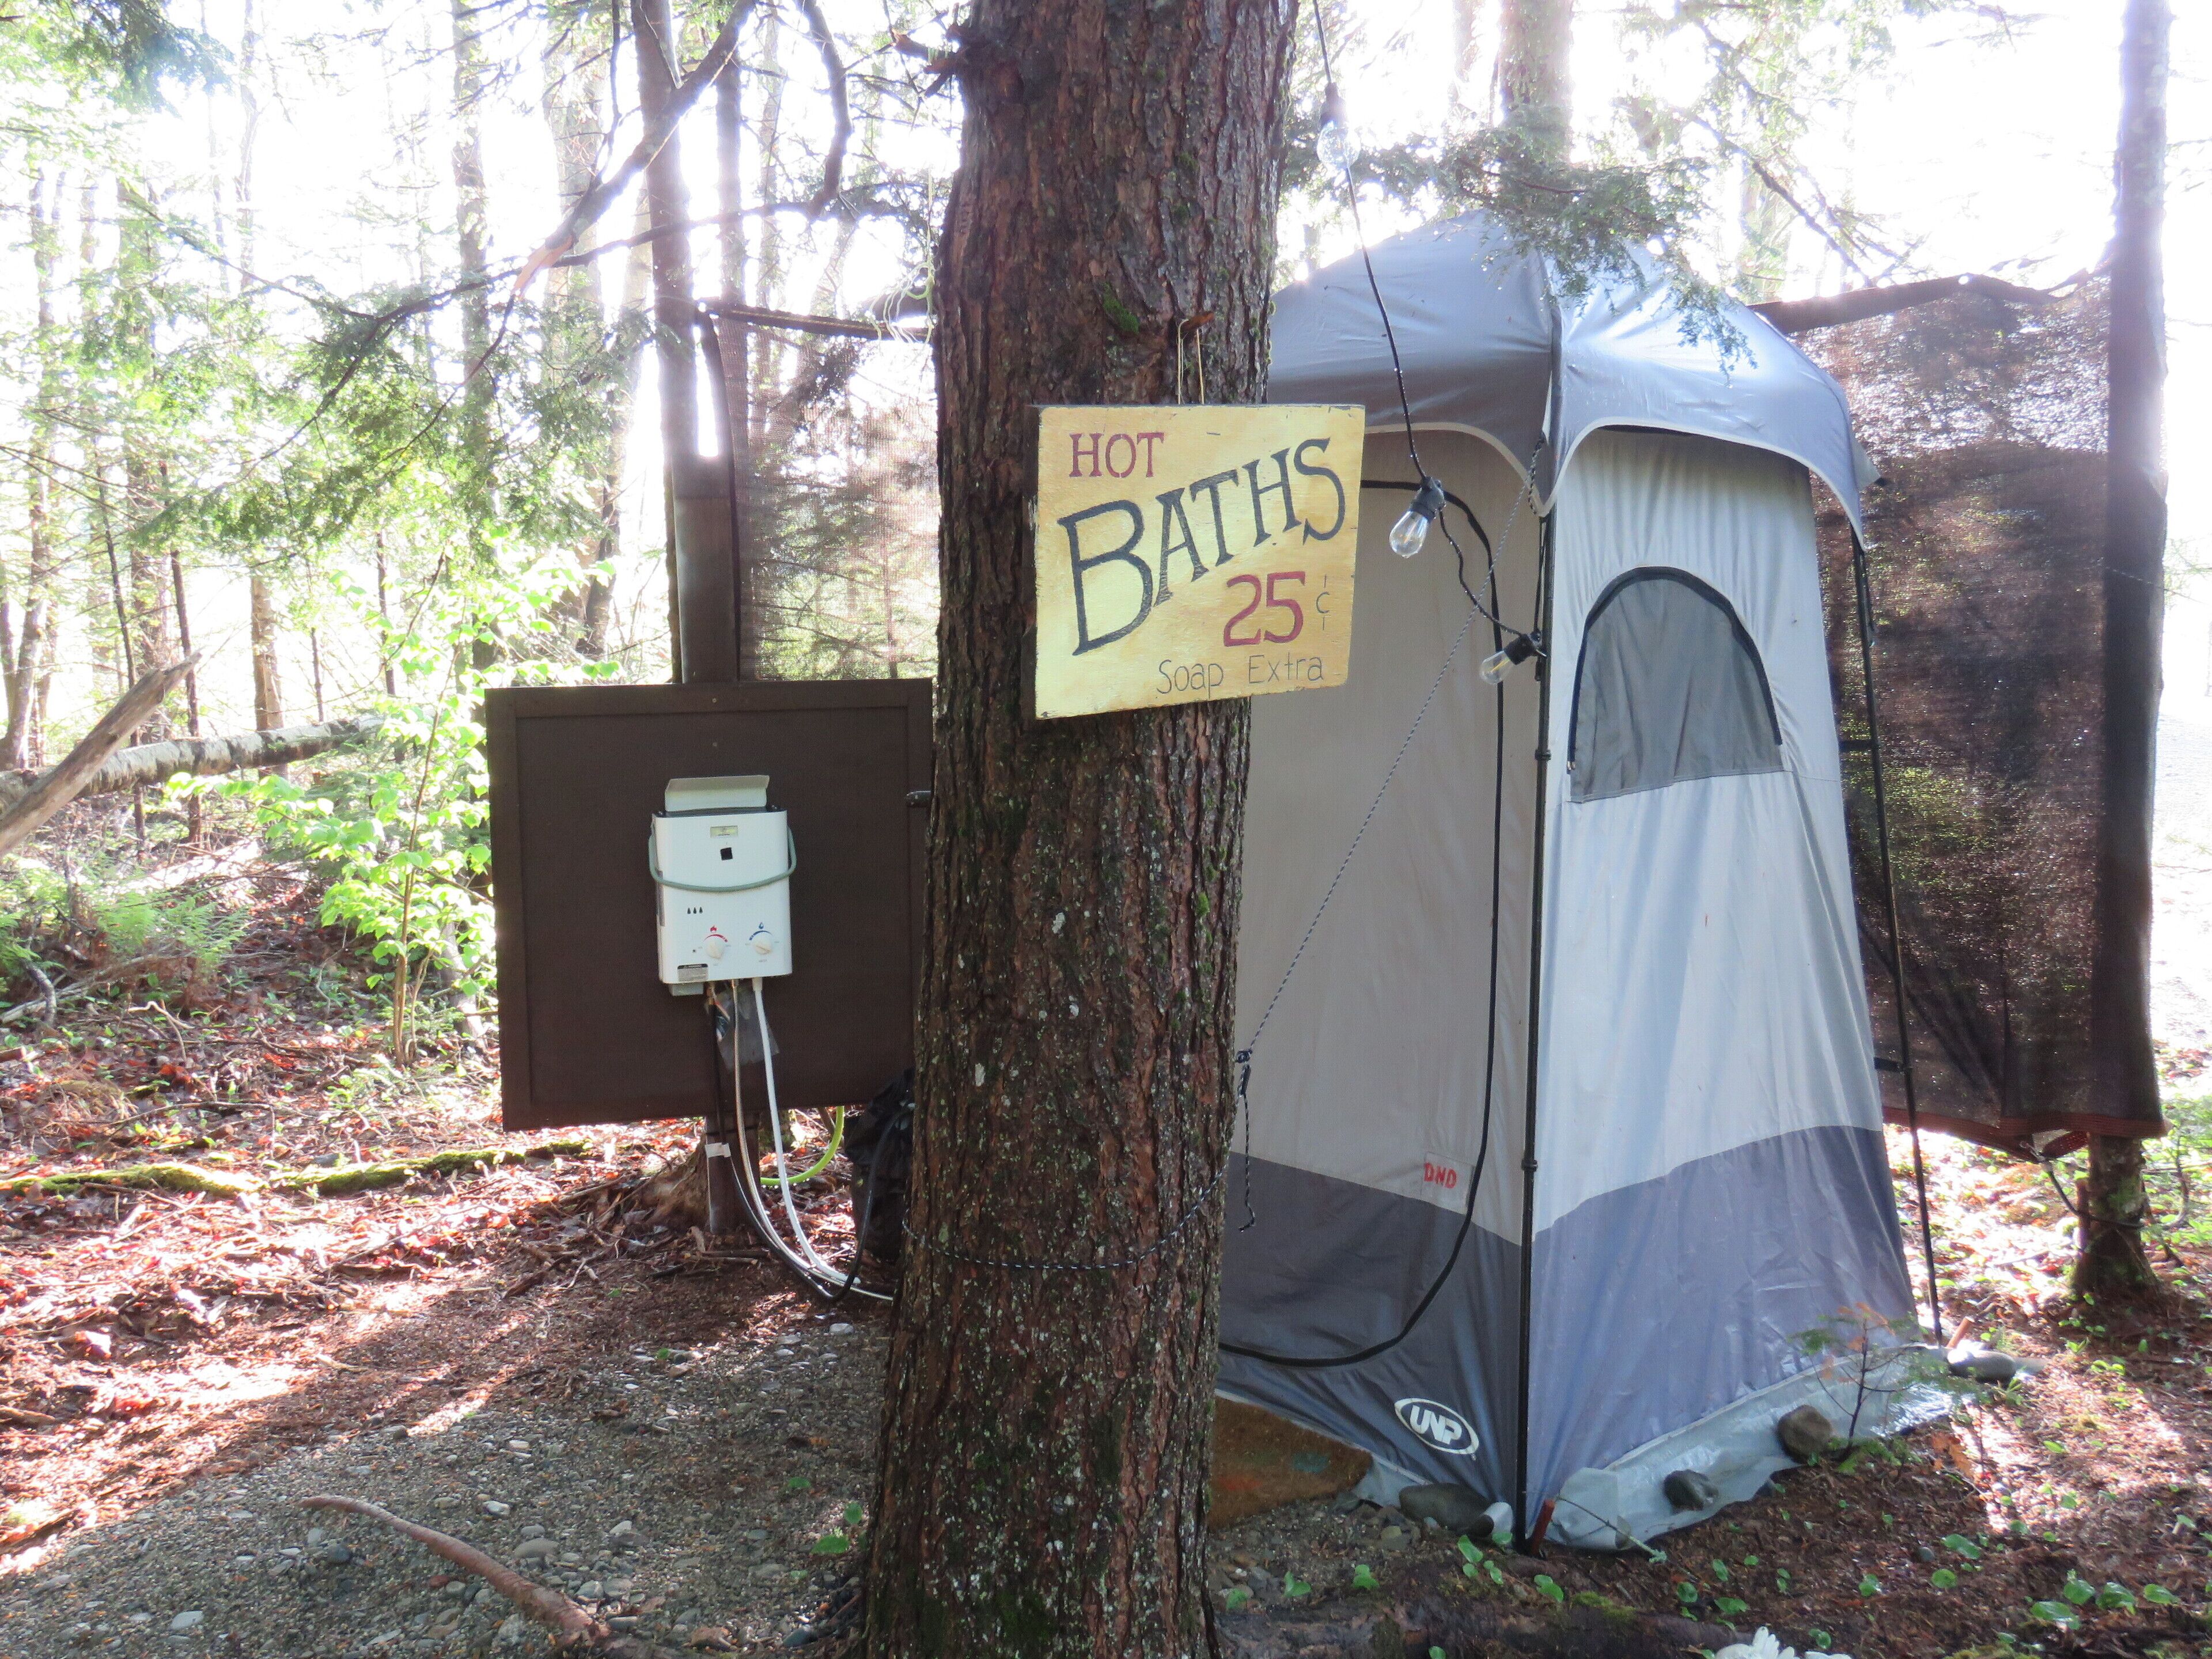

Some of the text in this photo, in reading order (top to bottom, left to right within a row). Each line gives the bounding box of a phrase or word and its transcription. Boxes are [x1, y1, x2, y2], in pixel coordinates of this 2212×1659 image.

[1069, 432, 1164, 478] HOT
[1057, 437, 1346, 656] BATHS
[1156, 652, 1324, 697] Soap Extra
[1409, 1405, 1463, 1445] UNP
